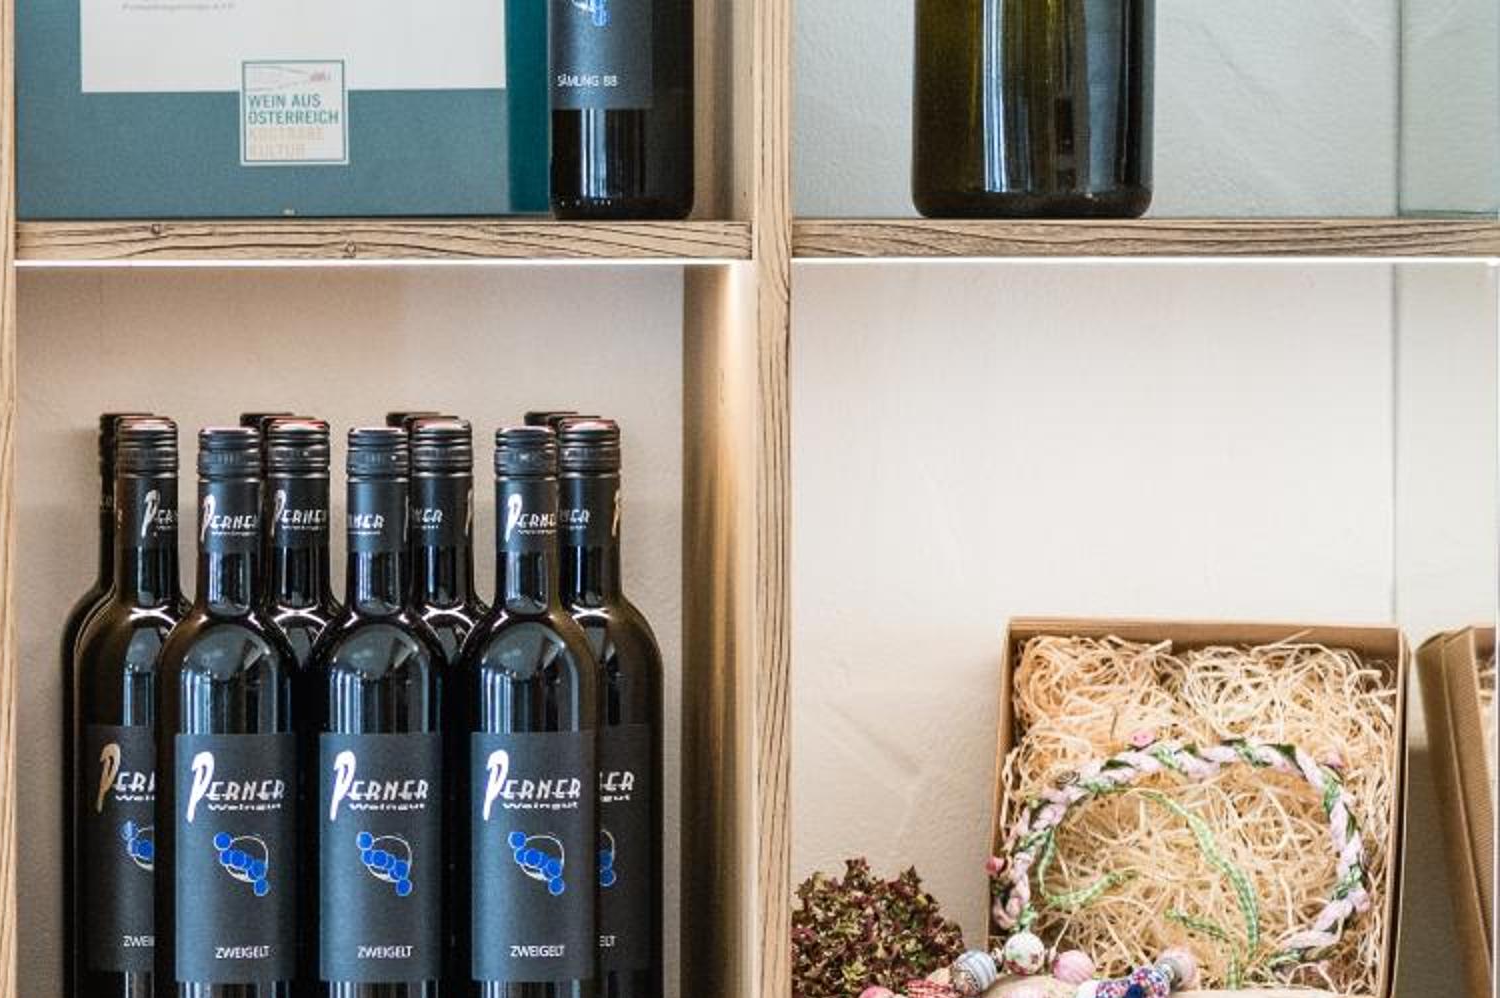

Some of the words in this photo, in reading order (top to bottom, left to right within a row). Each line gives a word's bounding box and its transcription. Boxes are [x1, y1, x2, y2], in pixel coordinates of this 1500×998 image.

[248, 94, 287, 109] WEIN
[291, 93, 322, 108] AUS
[186, 751, 285, 823] PERNER
[329, 750, 428, 822] PERNER
[483, 749, 581, 821] PERNER
[215, 945, 270, 959] ZWEIGELT
[357, 945, 413, 959] ZWEIGELT
[510, 945, 565, 958] ZWEIGELT
